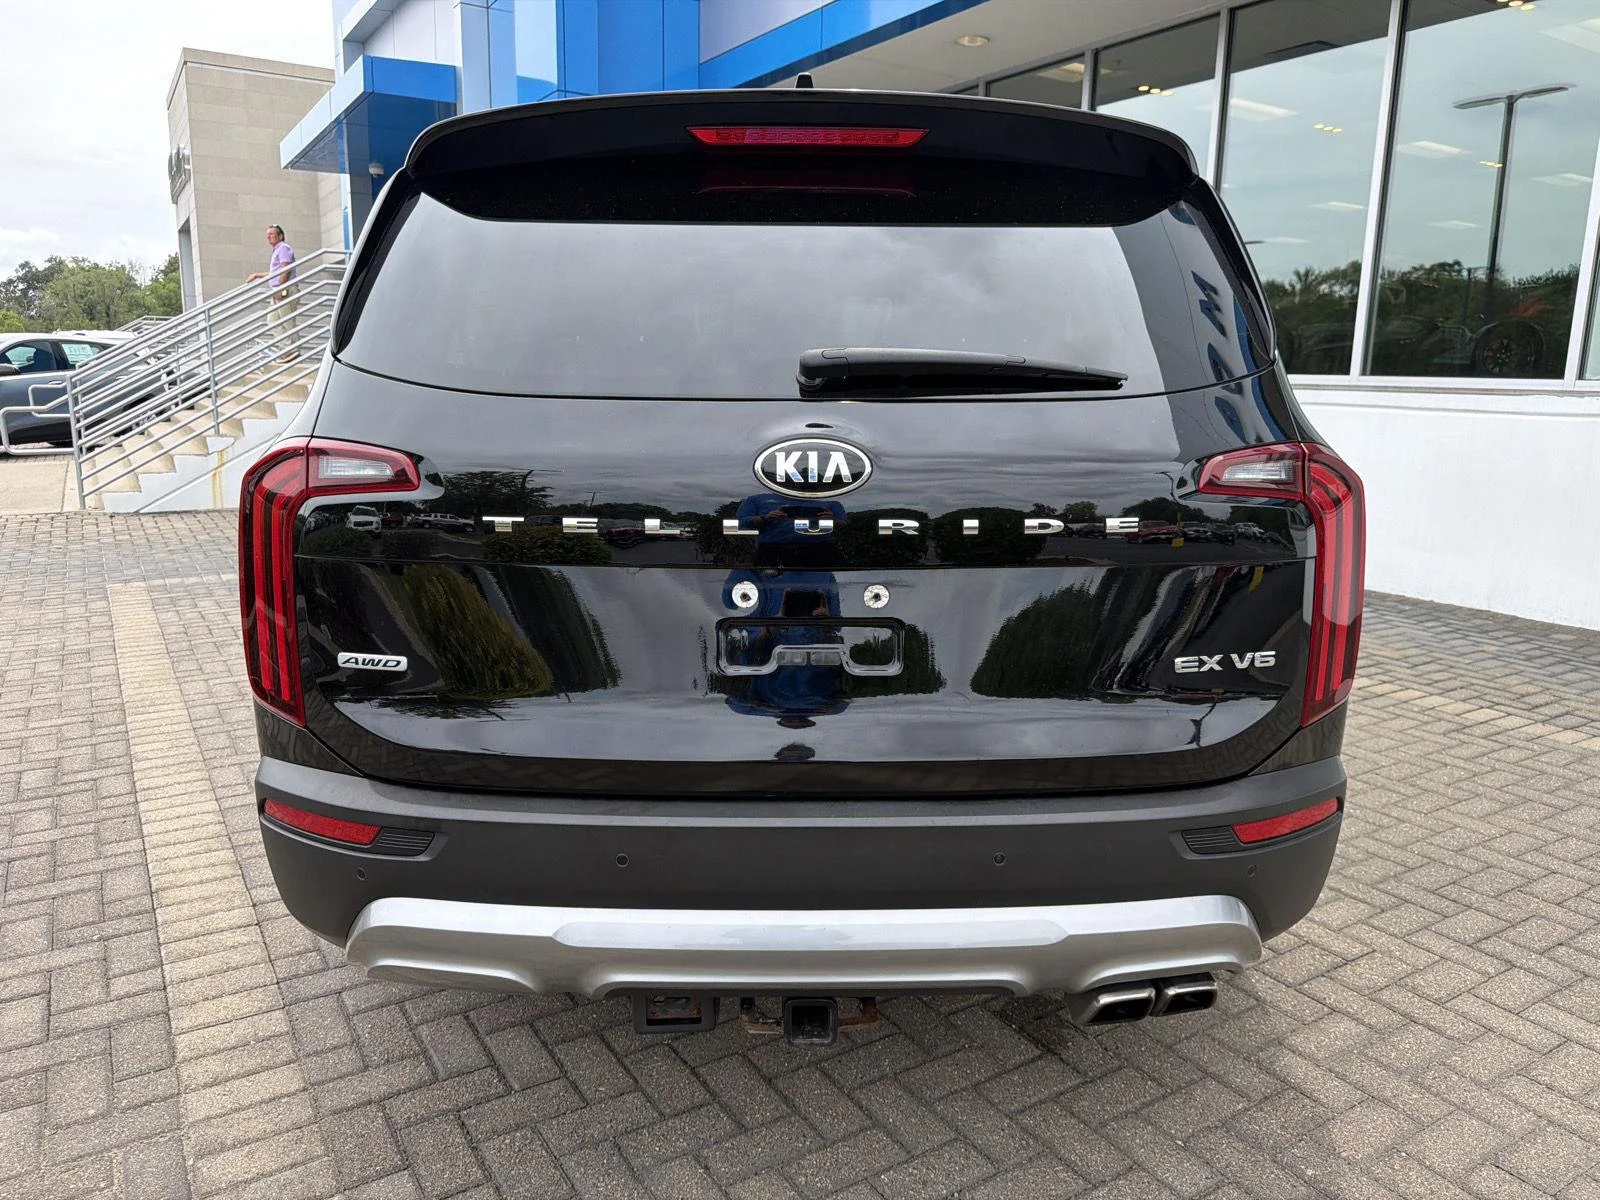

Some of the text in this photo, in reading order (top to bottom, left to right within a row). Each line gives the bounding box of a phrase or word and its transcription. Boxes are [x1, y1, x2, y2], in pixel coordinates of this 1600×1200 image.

[774, 450, 853, 483] KIA
[481, 515, 1141, 536] TELLURIDE
[341, 656, 402, 669] AWD
[1174, 650, 1276, 674] EX V6
